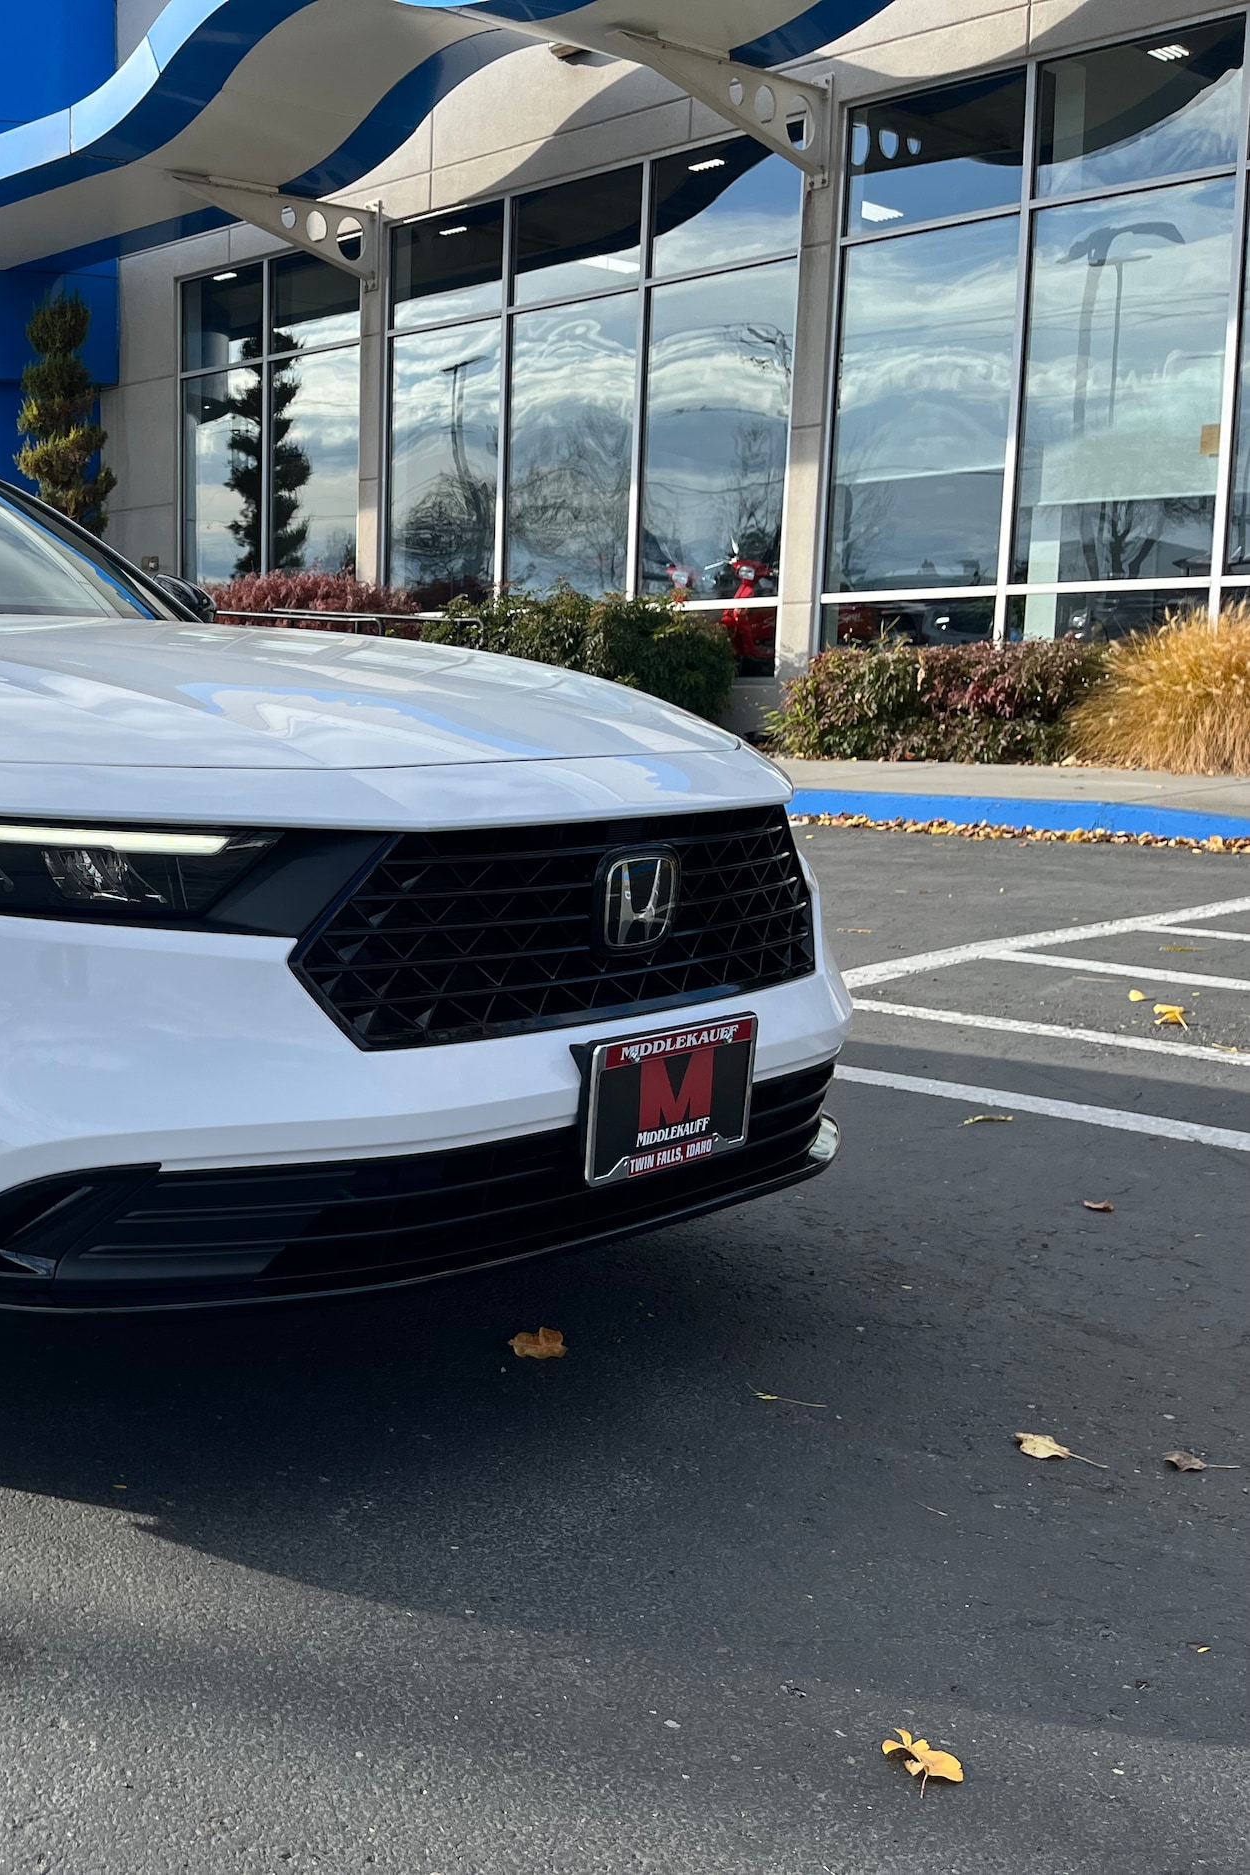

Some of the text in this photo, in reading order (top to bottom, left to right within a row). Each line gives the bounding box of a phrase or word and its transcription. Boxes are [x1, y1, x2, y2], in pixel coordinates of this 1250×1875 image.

[620, 1024, 739, 1061] MIDDLEKAUFF
[636, 1116, 710, 1148] MIDDLEKAUFF
[630, 1139, 712, 1173] TWIN FALLS, IDAHO
